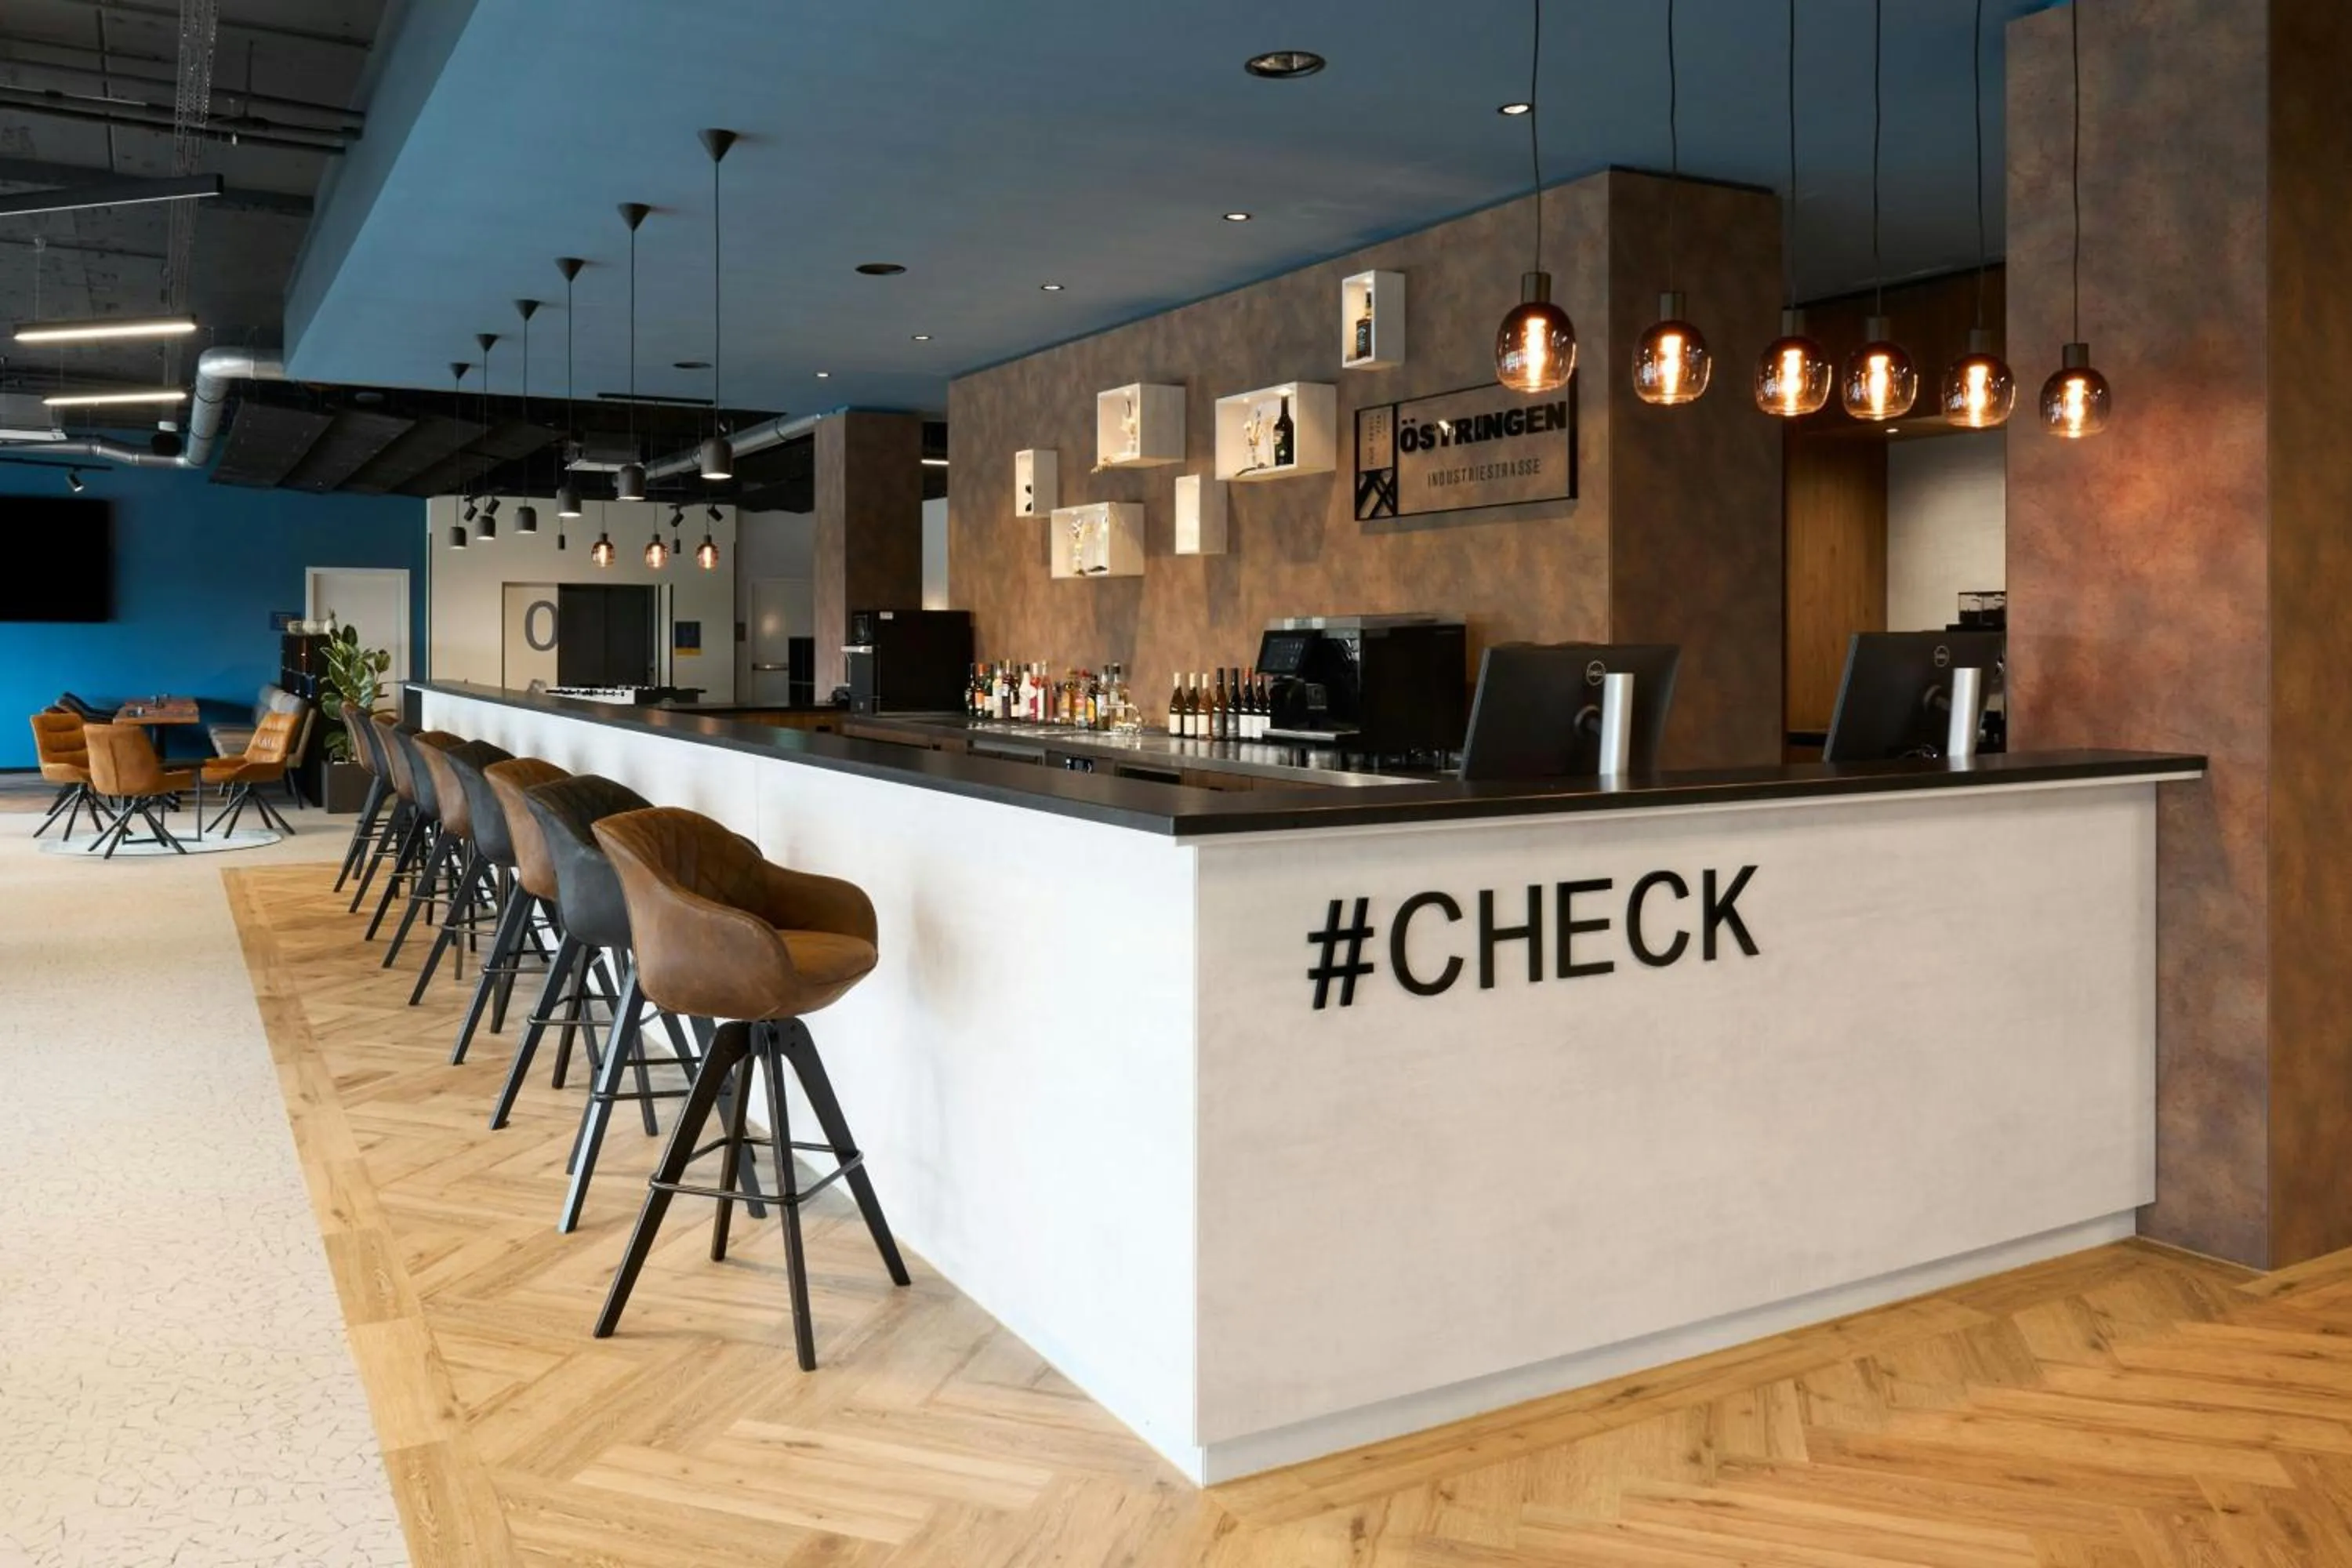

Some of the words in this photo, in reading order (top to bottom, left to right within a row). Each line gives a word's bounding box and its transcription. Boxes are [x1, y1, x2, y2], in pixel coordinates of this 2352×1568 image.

[1399, 401, 1567, 453] ÖSTRINGEN
[1427, 458, 1542, 488] INDUSTRIESTRASSE
[1307, 864, 1760, 1010] #CHECK
